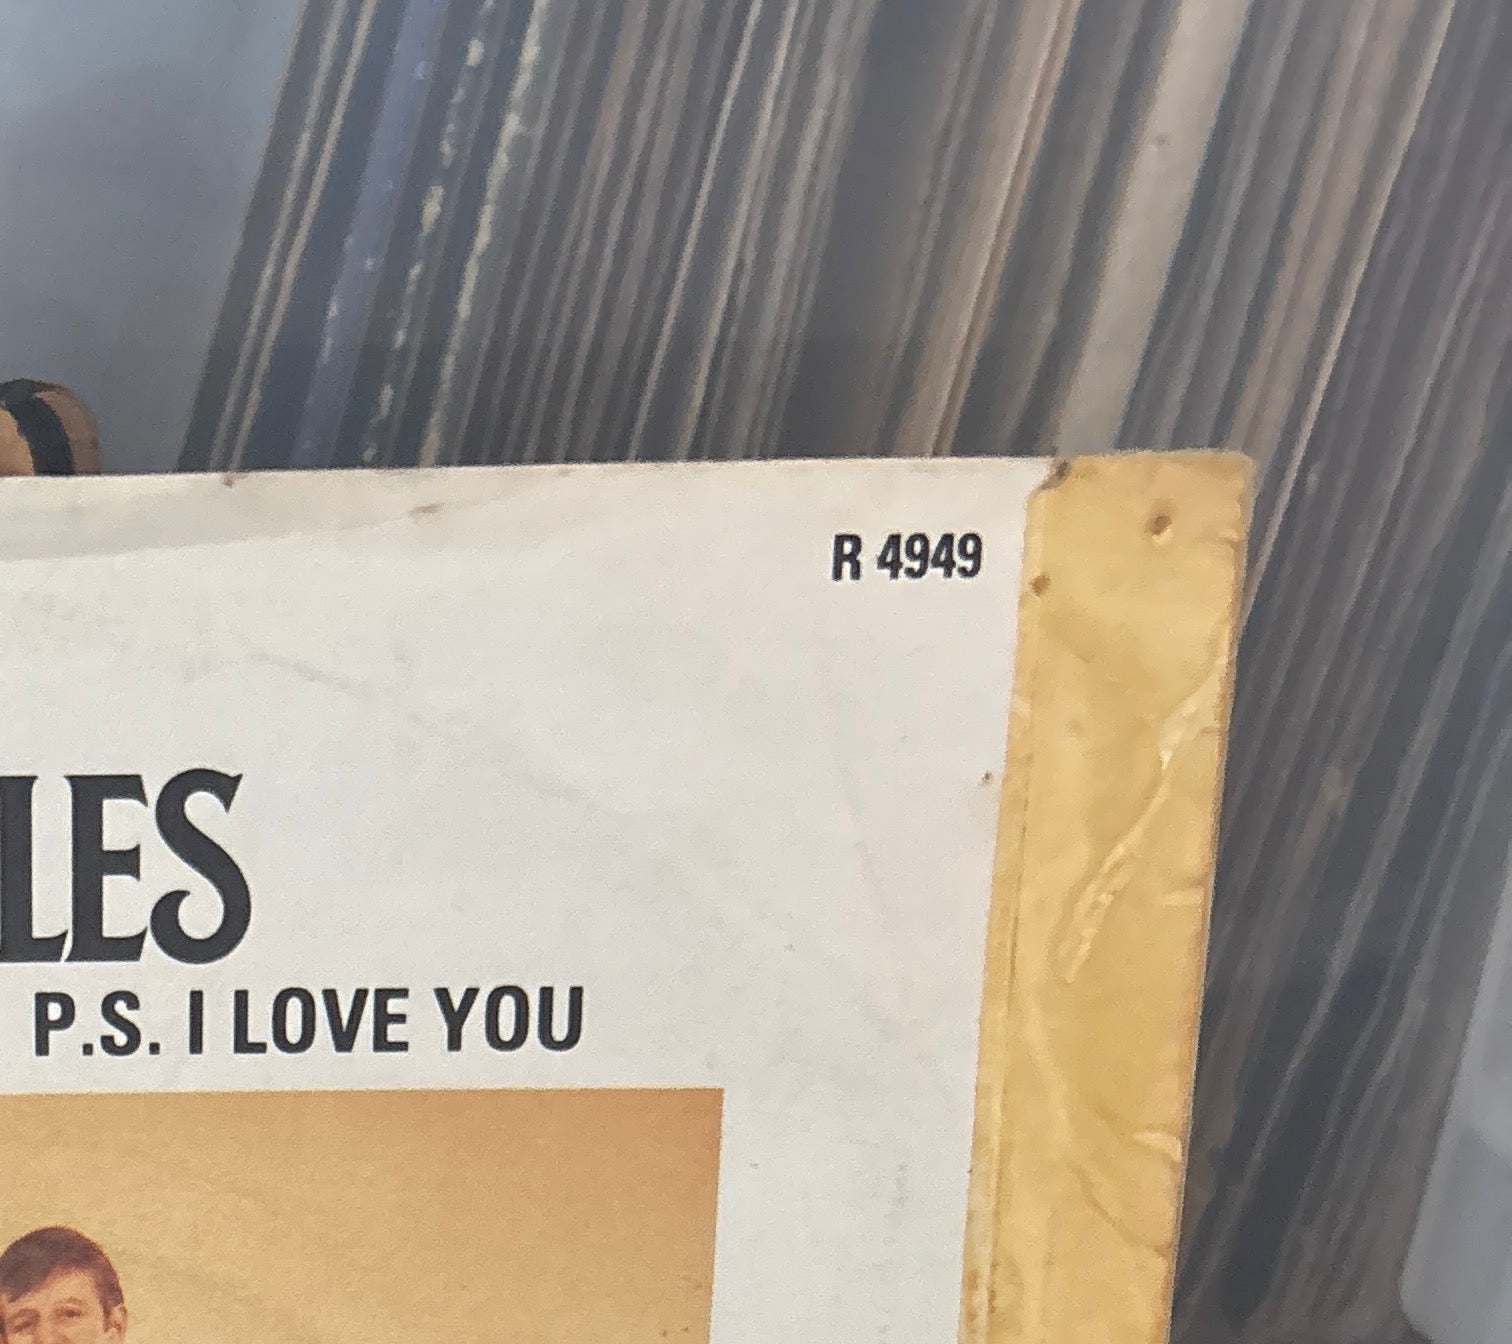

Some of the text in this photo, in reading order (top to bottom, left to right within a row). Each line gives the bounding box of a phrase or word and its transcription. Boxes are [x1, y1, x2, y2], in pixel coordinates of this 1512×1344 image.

[831, 532, 983, 582] R 4949
[34, 984, 584, 1057] P.S. I LOVE YOU
